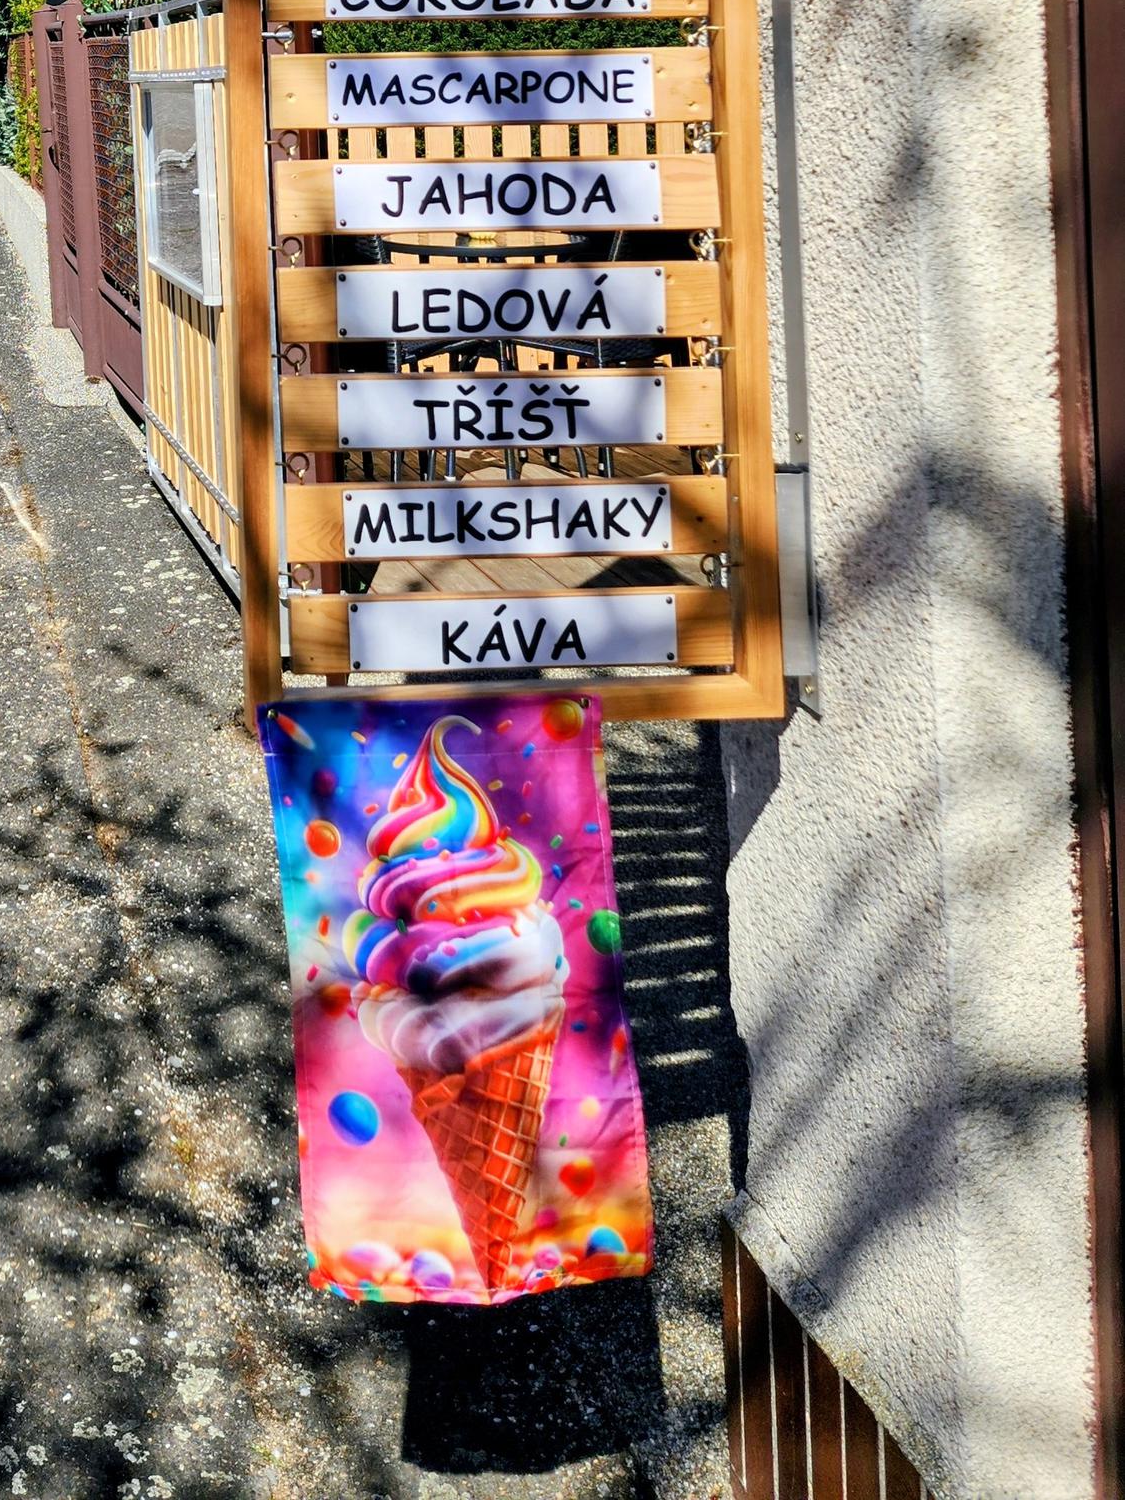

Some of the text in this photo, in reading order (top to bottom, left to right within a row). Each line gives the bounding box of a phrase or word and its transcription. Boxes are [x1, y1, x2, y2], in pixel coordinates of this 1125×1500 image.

[341, 69, 635, 106] MASCARPONE
[381, 172, 616, 218] JAHODA
[391, 273, 611, 334] LEDOVÁ
[412, 381, 591, 442] TŘÍŠŤ
[353, 495, 664, 545] MILKSHAKY
[441, 603, 587, 665] KÁVA
